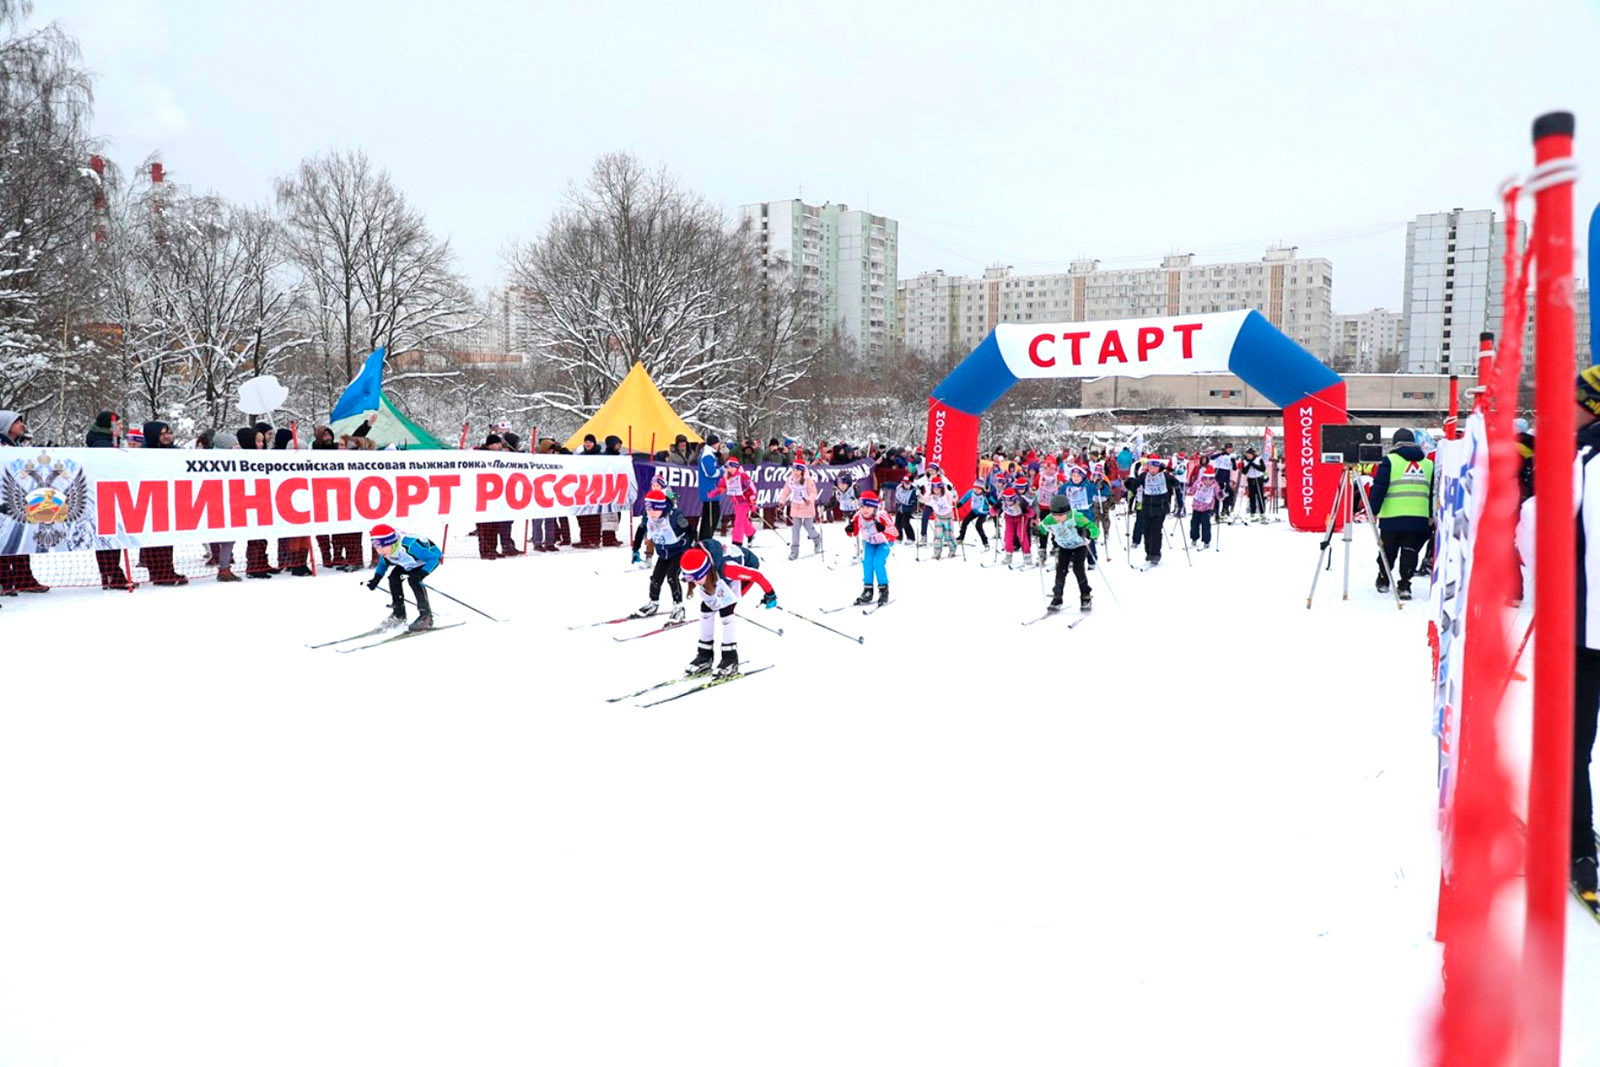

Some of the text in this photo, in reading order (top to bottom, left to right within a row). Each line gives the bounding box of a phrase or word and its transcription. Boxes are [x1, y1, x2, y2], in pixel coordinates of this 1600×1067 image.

[1028, 322, 1203, 368] СТАРТ
[932, 410, 946, 466] МОСКОМ
[1299, 406, 1314, 516] МОСКОМСПОРТ
[185, 460, 236, 472] XXXVI
[239, 459, 345, 475] Всероссийская
[347, 460, 406, 471] массовая
[408, 460, 456, 470] лыжная
[457, 460, 487, 470] гонка
[96, 474, 461, 535] МИНСПОРТ
[475, 472, 629, 512] РОССИИ
